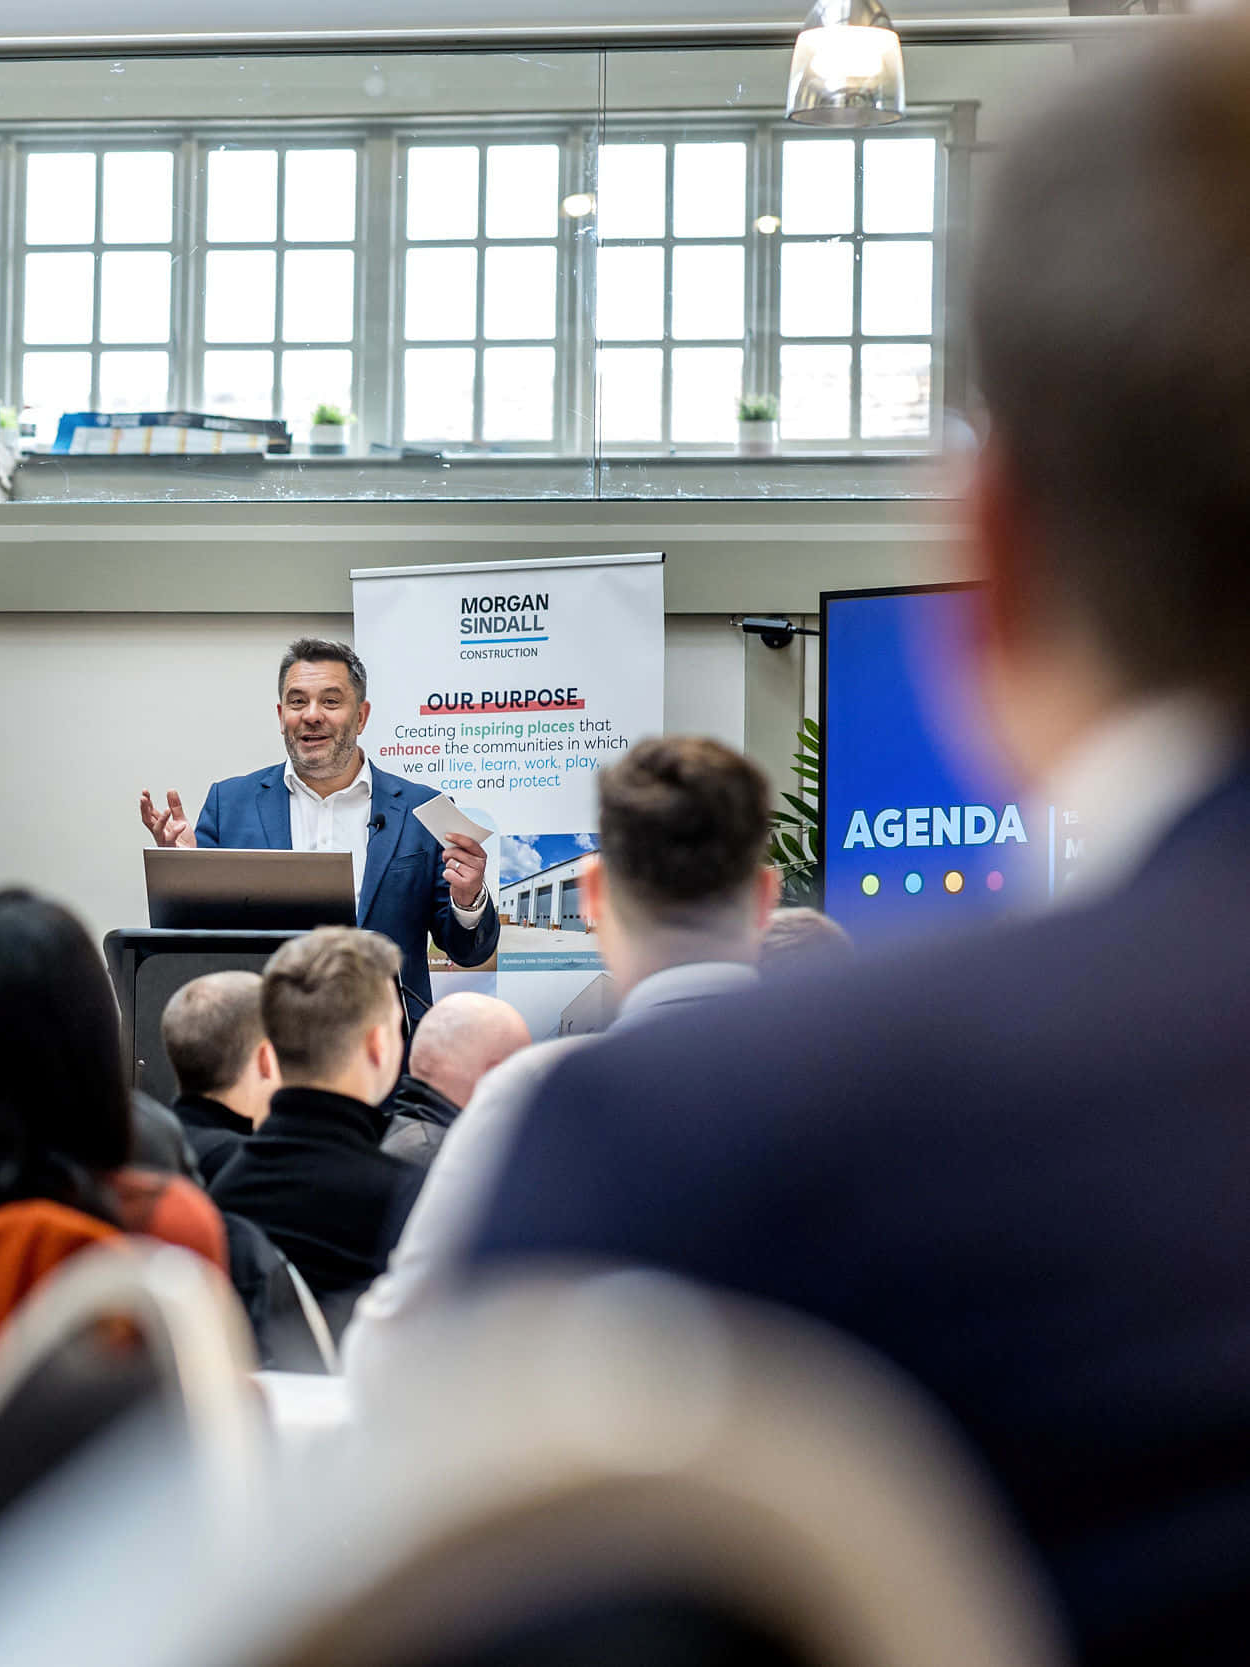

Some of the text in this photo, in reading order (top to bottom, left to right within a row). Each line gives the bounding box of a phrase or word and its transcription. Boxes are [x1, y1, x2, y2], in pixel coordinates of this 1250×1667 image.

[461, 593, 549, 614] MORGAN
[460, 615, 545, 634] SINDALL
[460, 648, 538, 660] CONSTRUCTION
[427, 688, 579, 711] OUR PURPOSE
[395, 718, 612, 740] Creating inspiring places that
[380, 735, 629, 756] enhance the communities in which
[403, 763, 423, 773] we
[427, 759, 444, 773] all
[565, 754, 600, 772] play,
[441, 774, 561, 792] care and protect
[843, 804, 1029, 849] AGENDA
